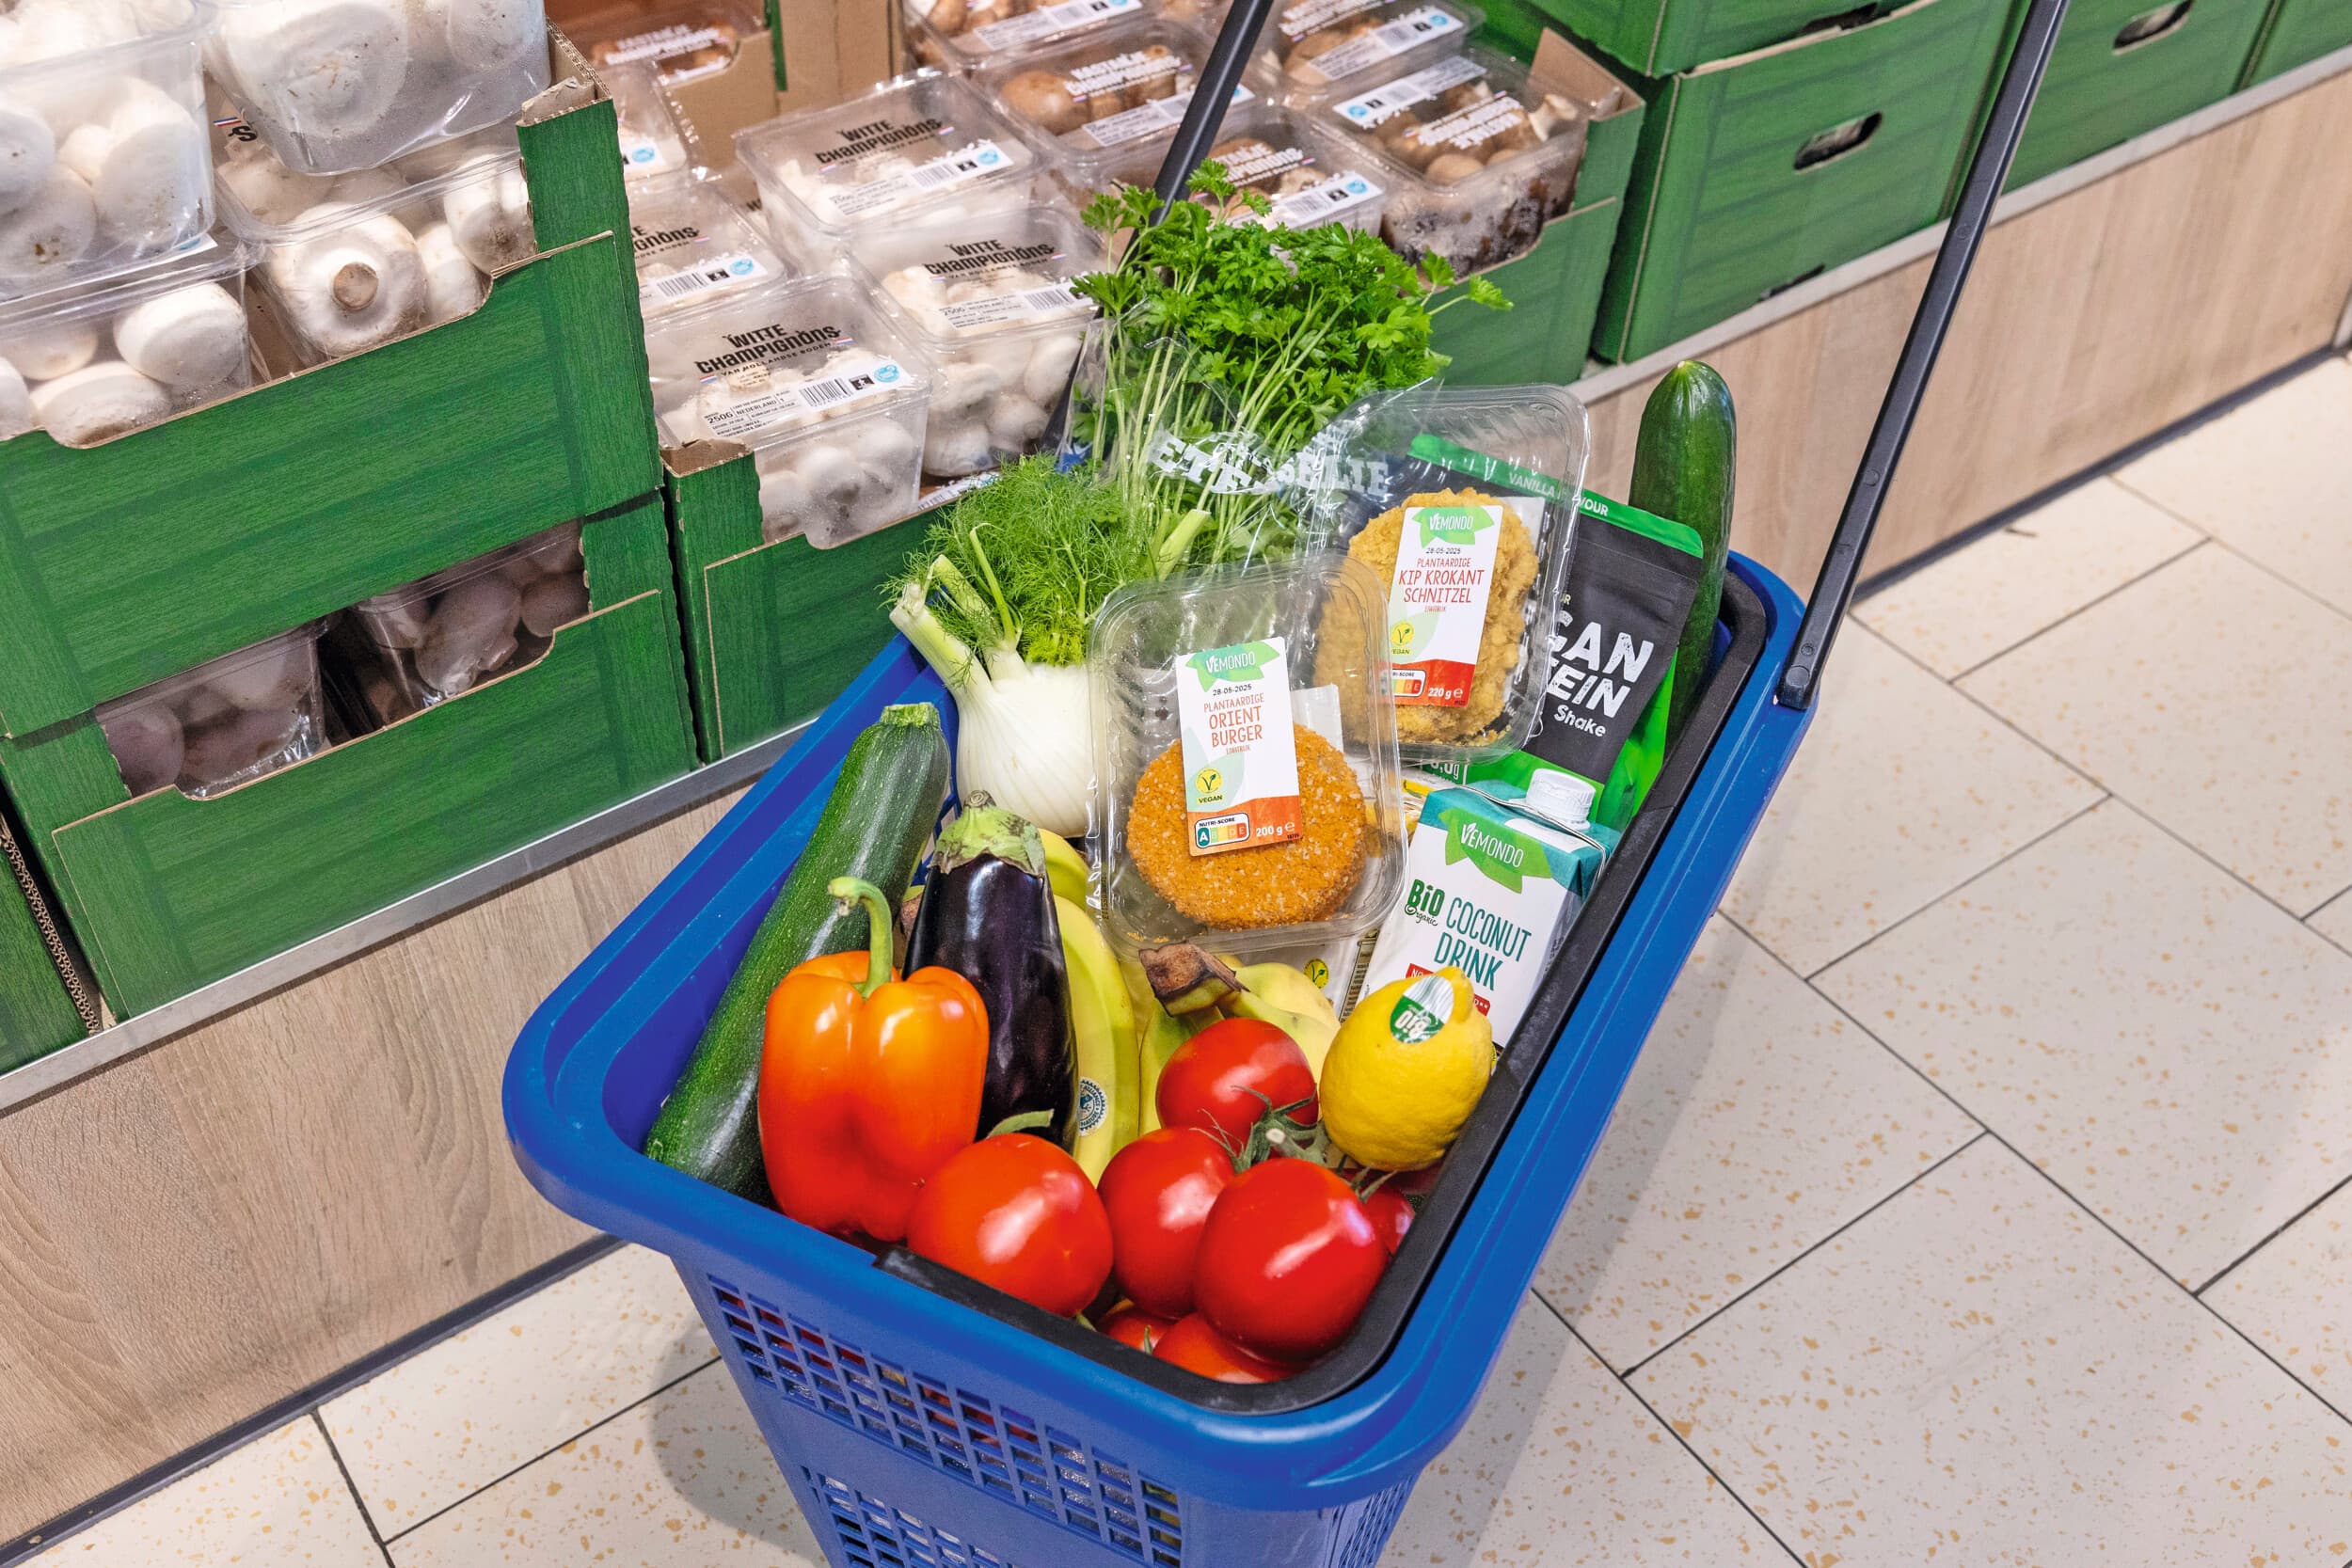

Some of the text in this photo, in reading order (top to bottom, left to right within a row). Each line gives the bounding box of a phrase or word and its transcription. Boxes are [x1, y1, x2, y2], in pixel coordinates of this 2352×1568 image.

[837, 119, 894, 142] WITTE
[945, 239, 1005, 257] WITTE
[723, 324, 787, 349] WITTE
[707, 411, 734, 424] 250G
[1509, 473, 1555, 498] VANILLA
[1430, 513, 1474, 531] VEMONDO
[1417, 558, 1471, 568] PLANTAARDIGE
[1399, 570, 1485, 585] KIP KROKANT
[1404, 588, 1471, 603] SCHNITZEL
[1206, 651, 1255, 673] VEMONDO
[1213, 684, 1252, 696] 28-05-2025
[1428, 688, 1444, 697] 220
[1445, 690, 1452, 700] g
[1203, 693, 1264, 713] PLANTAARDIGE
[1209, 705, 1262, 730] ORIENT
[1554, 705, 1606, 737] Shake
[1211, 724, 1263, 748] BURGER
[1198, 795, 1223, 803] VEGAN
[1199, 817, 1235, 827] NUTRI-SCORE
[1200, 831, 1209, 843] A
[1256, 826, 1274, 837] 200
[1277, 827, 1283, 835] g
[1460, 822, 1524, 868] VEMONDO
[1446, 896, 1532, 962] COCONUT
[1434, 931, 1503, 991] DRINK
